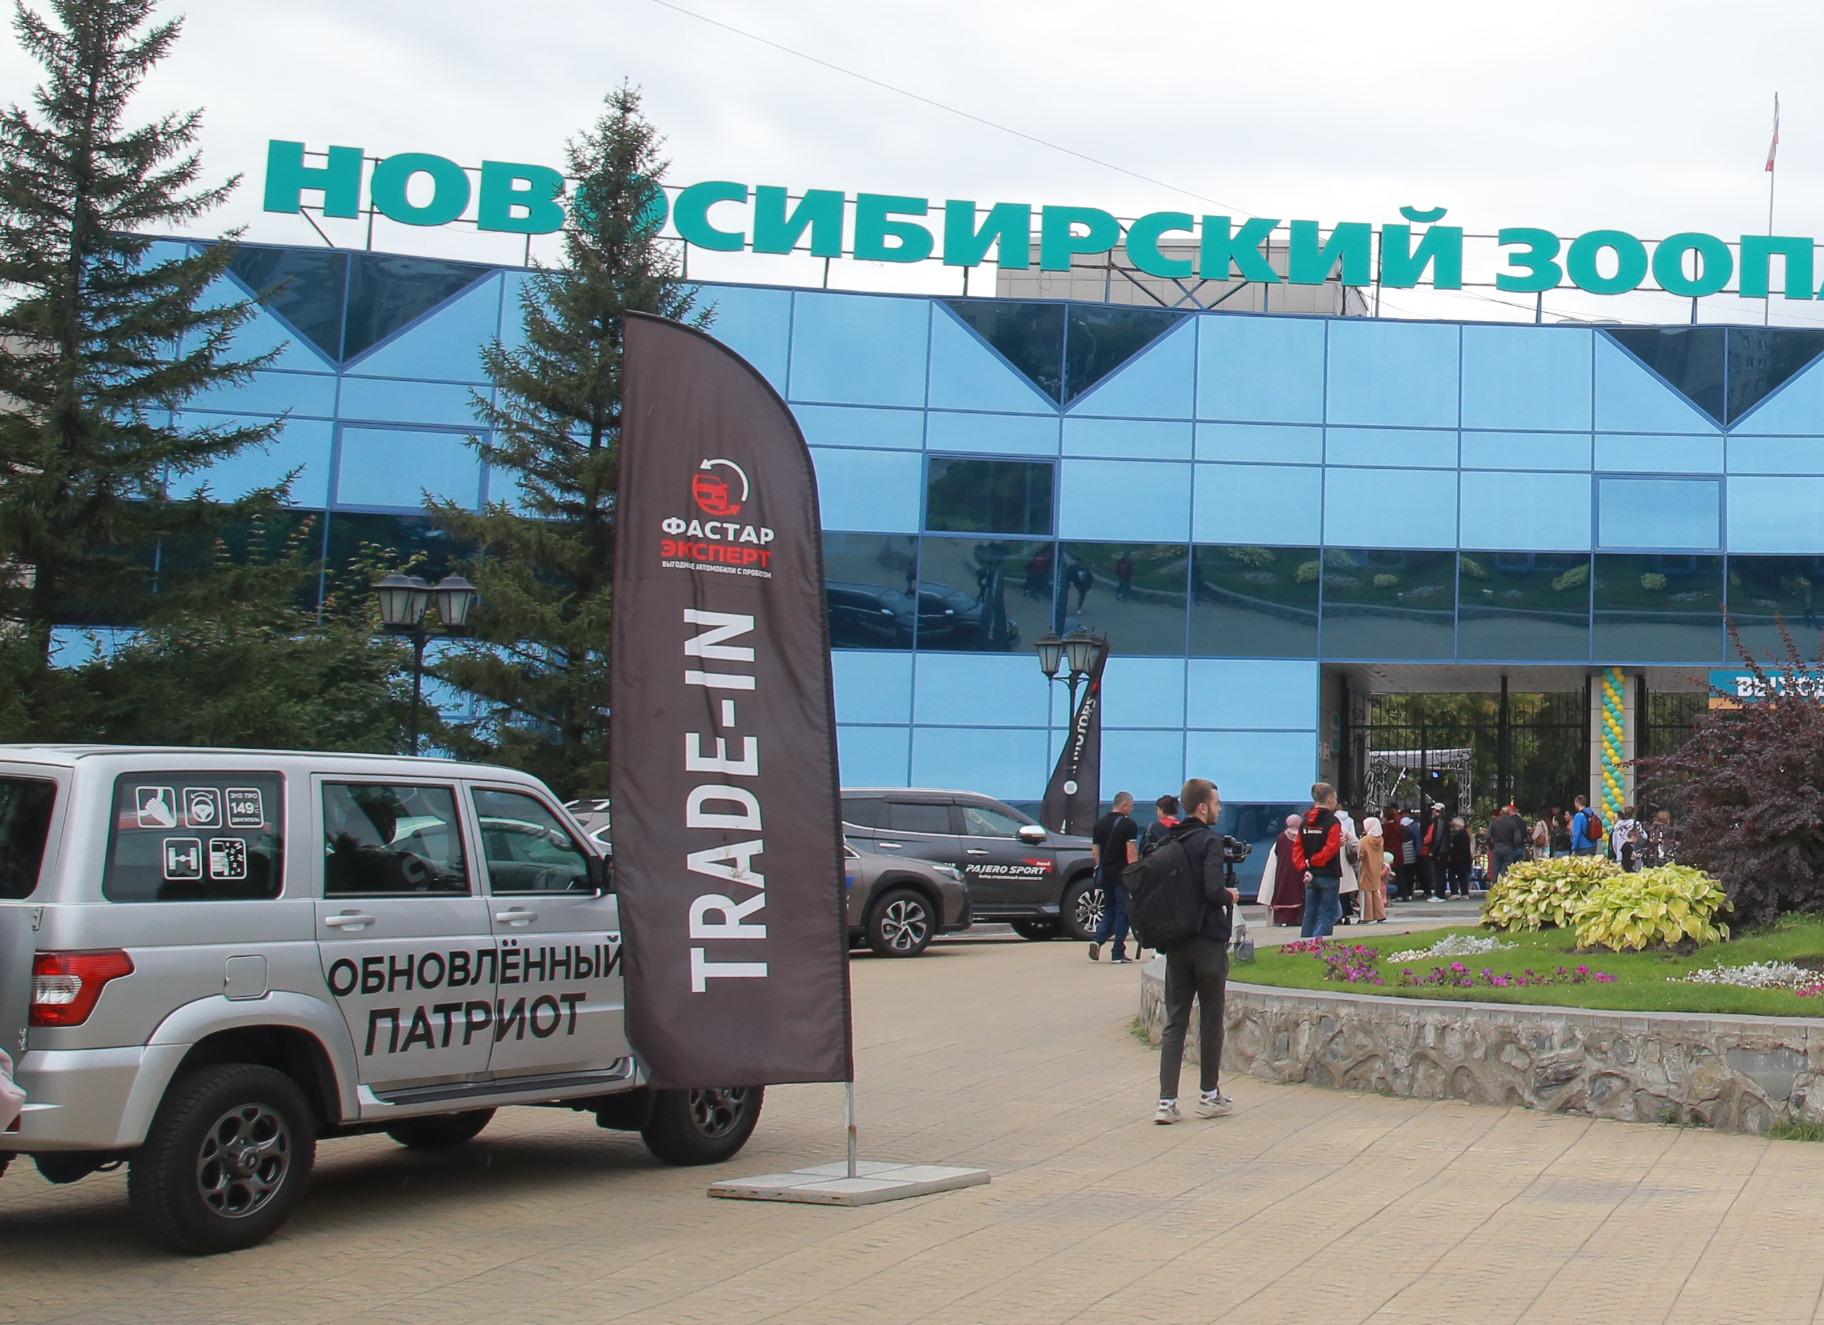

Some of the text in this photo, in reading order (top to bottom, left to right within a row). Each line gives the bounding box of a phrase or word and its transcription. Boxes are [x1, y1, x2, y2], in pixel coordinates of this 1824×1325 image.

[263, 139, 1463, 290] НОВОСИБИРСКИЙ
[662, 517, 775, 545] ФАСТАР
[661, 539, 772, 567] ЭКСПЕРТ
[695, 563, 736, 575] АВТОМОБИЛИ
[230, 802, 255, 814] 149
[683, 608, 768, 993] TRADE-IN
[965, 864, 1008, 874] PAJERO
[1009, 866, 1046, 875] SPORT
[328, 935, 624, 998] ОБНОВЛЁННЫЙ
[364, 992, 587, 1057] ПАТРИОТ
